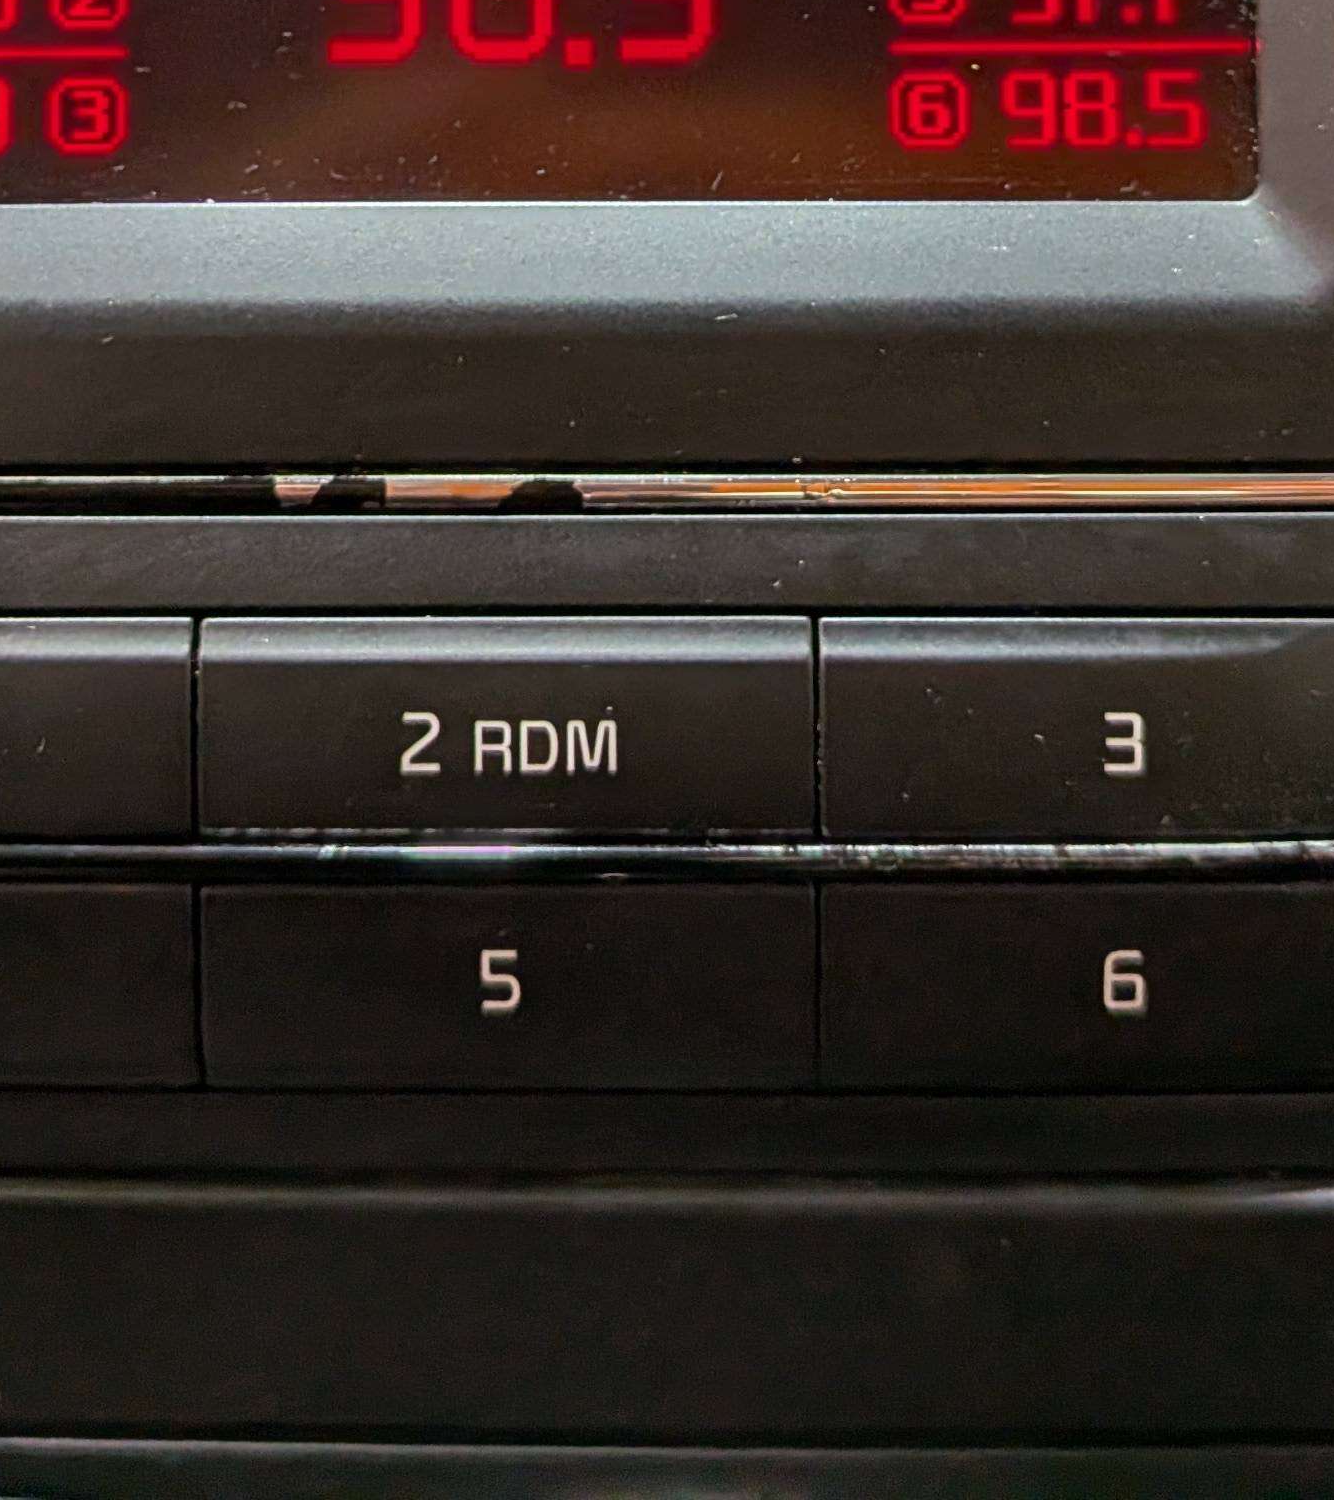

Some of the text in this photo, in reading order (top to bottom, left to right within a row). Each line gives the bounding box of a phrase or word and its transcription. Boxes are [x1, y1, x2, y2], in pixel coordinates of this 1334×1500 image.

[1002, 70, 1207, 150] 98.5
[399, 711, 618, 776] 2 RDM
[1102, 711, 1147, 777] 3
[479, 948, 523, 1016] 5
[1102, 949, 1148, 1016] 6
